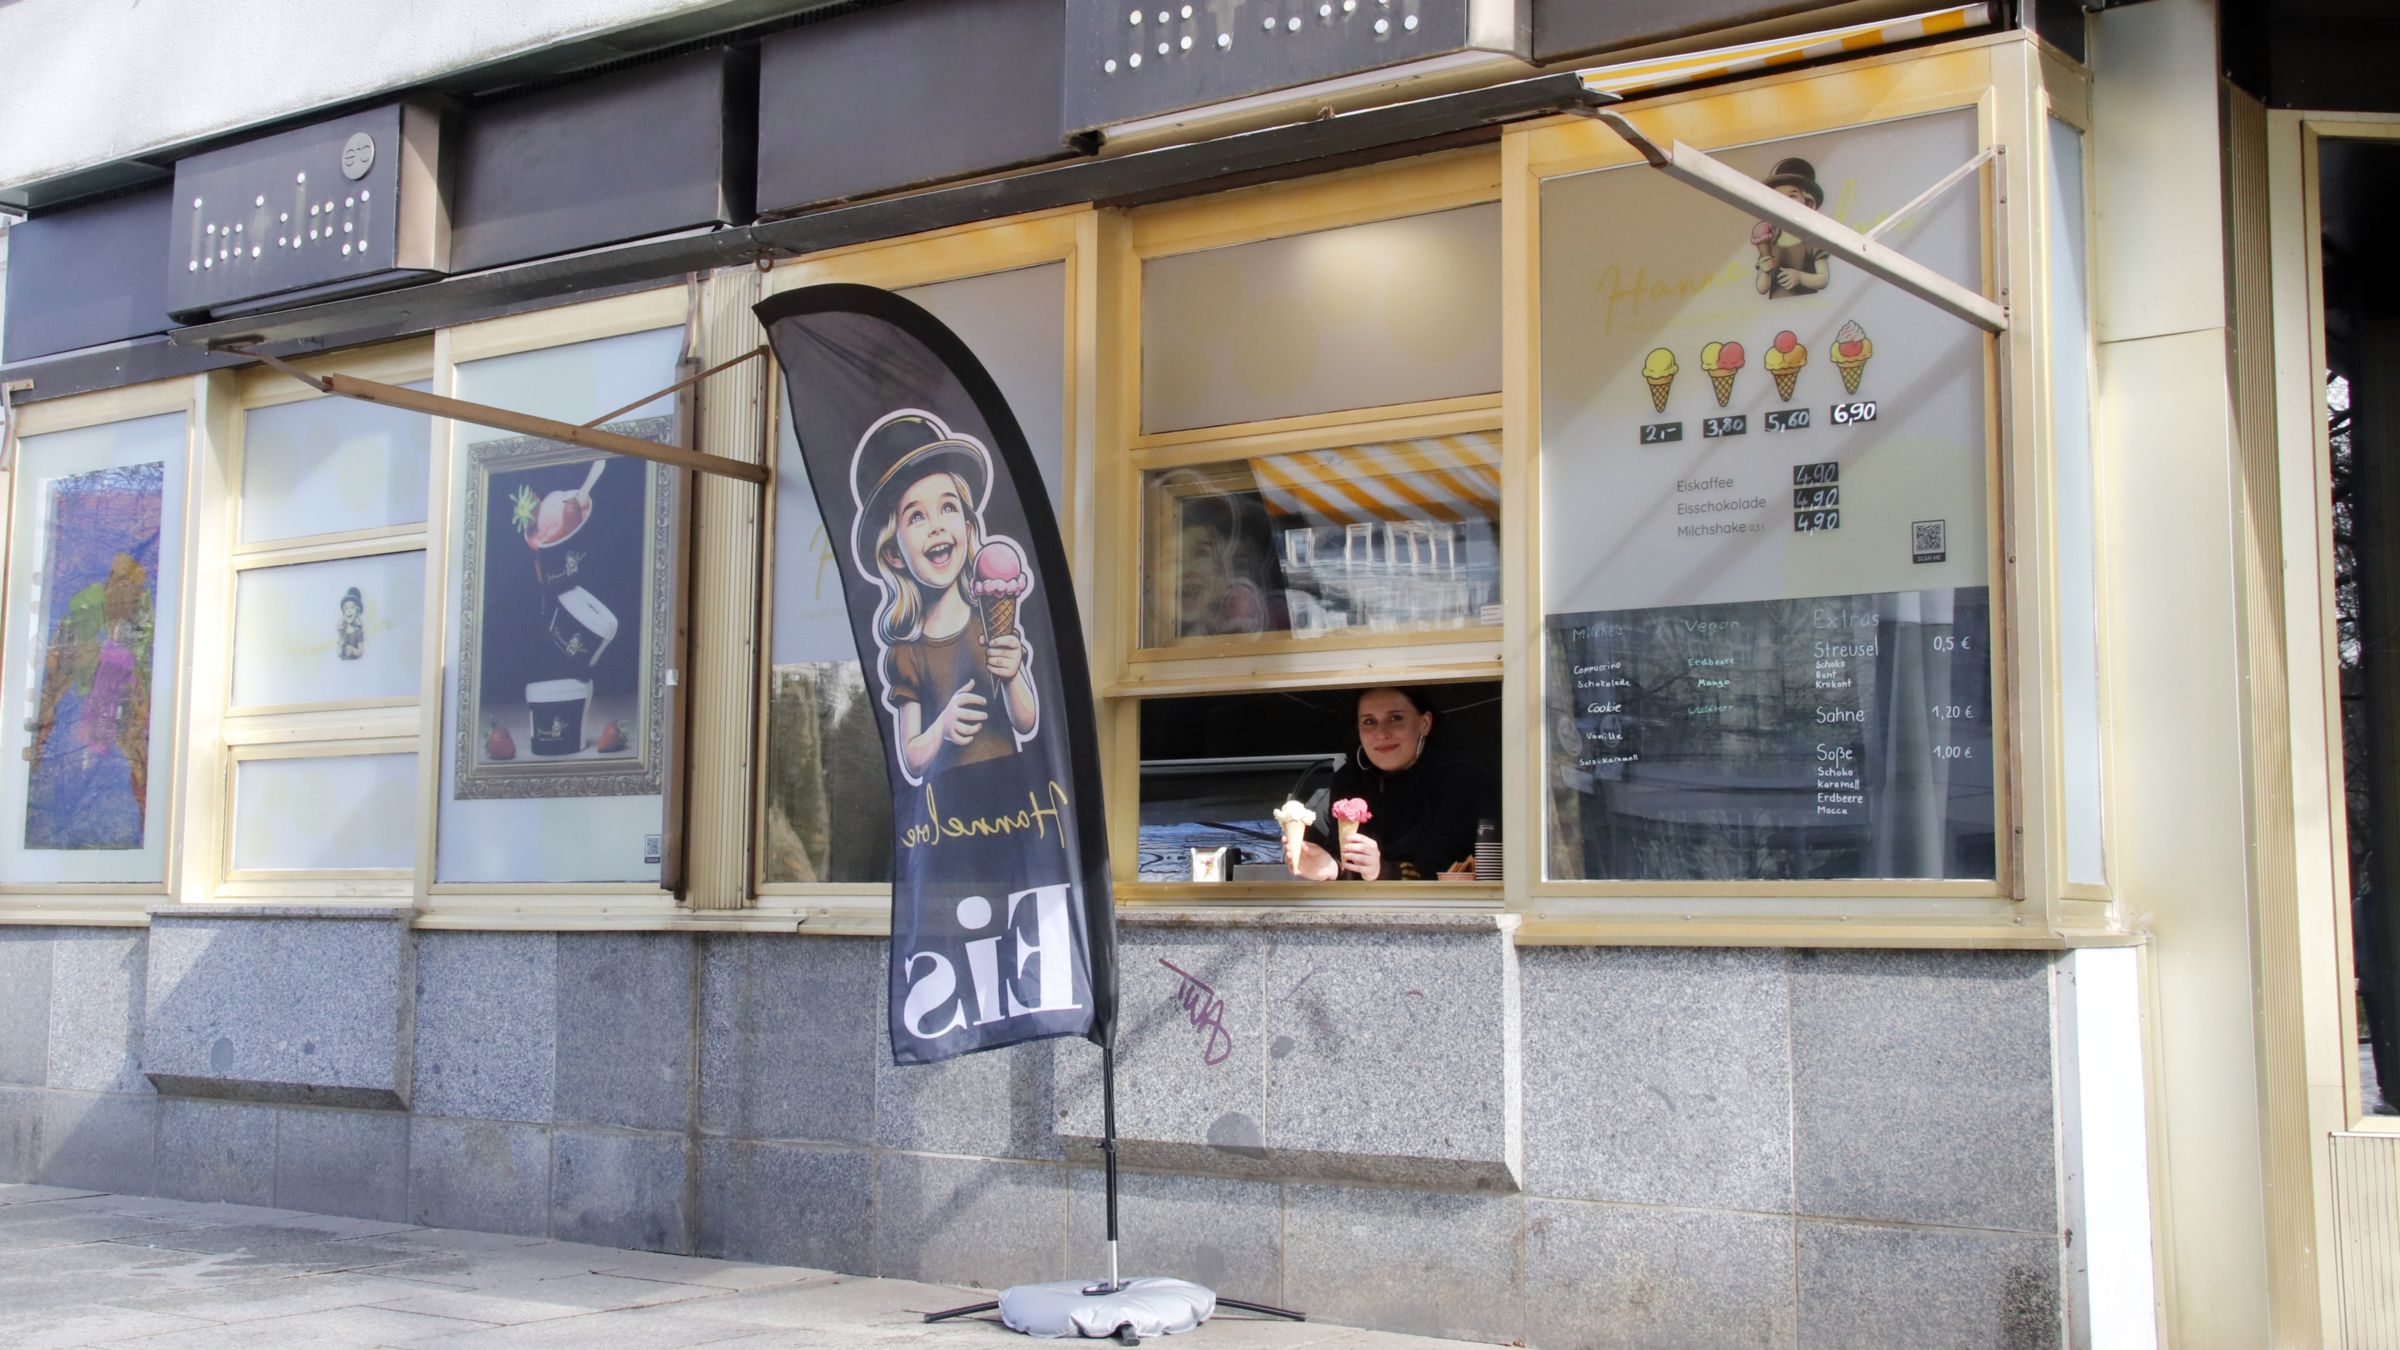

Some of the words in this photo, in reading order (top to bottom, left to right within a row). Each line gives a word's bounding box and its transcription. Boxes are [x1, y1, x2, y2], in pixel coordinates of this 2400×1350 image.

[1834, 402, 1876, 426] 6,90
[1707, 417, 1745, 436] 3,80
[1767, 410, 1809, 433] 5,60
[1677, 476, 1735, 493] Eiskaffee
[1795, 463, 1837, 486] 4,90
[1677, 496, 1767, 515] Eisschokolade
[1796, 487, 1838, 511] 4,90
[1677, 521, 1746, 537] Milchshake
[1797, 511, 1839, 536] 4,90
[1814, 608, 1879, 629] Extras
[1814, 635, 1879, 659] Streusel
[1933, 636, 1954, 652] 0,5
[1961, 636, 1971, 650] €
[1815, 660, 1846, 669] Schoko
[1815, 669, 1837, 679] Bunt
[1577, 680, 1632, 689] Schokolade
[1697, 678, 1730, 688] Mango
[1815, 678, 1853, 689] Krokant
[1587, 702, 1622, 714] Cookie
[1816, 705, 1865, 724] Sahne
[1932, 705, 1960, 720] 1,20
[1965, 705, 1974, 719] €
[1586, 732, 1624, 741] Vanille
[1816, 743, 1854, 768] Soße
[1932, 746, 1961, 760] 1,00
[1965, 746, 1974, 759] €
[1817, 766, 1854, 777] Schoko
[1817, 779, 1860, 790] Karamell
[1817, 792, 1863, 804] Erdbeere
[1817, 805, 1848, 815] Mocca
